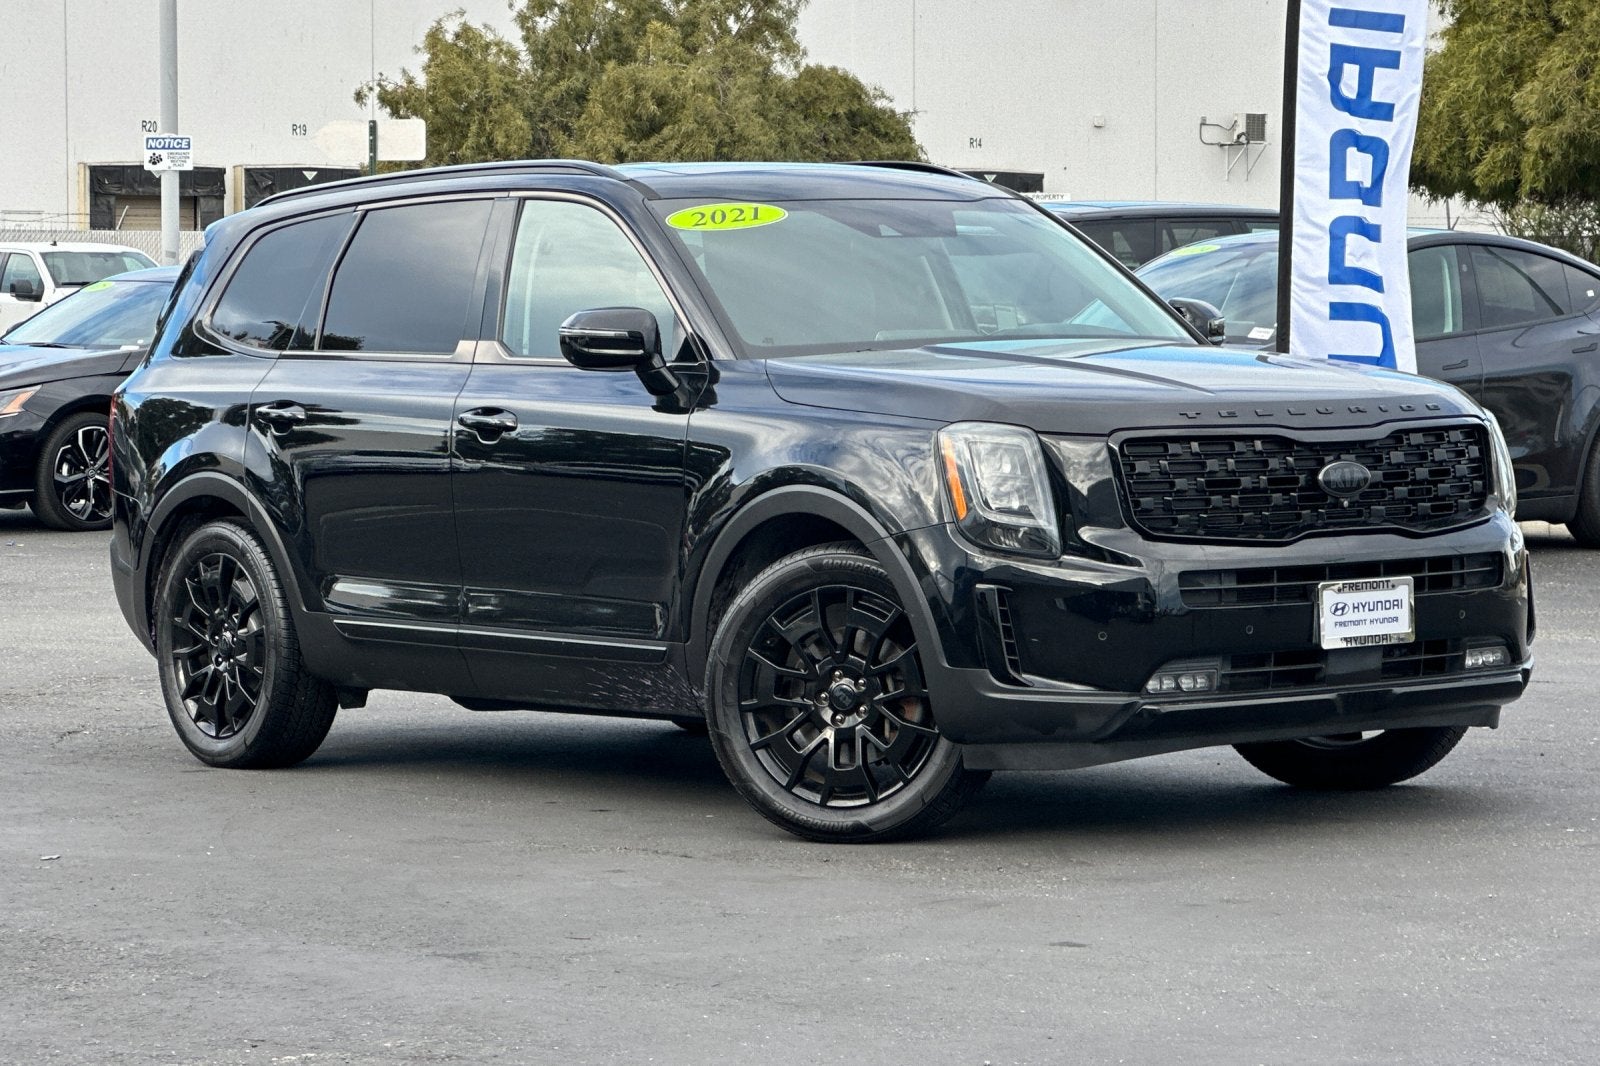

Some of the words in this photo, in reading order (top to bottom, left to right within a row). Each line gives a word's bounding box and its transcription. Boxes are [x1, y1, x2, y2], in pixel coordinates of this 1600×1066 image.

[141, 120, 158, 133] R20
[292, 124, 307, 136] R19
[147, 138, 190, 149] NOTICE
[969, 138, 982, 149] R14
[691, 207, 761, 227] 2021
[1179, 403, 1441, 419] TELLURIDE
[1330, 467, 1366, 489] KIA
[1342, 579, 1391, 592] FREMONT
[1352, 598, 1403, 614] HYUNDAI
[1334, 618, 1367, 628] FREMONT
[1369, 616, 1399, 626] HYUNDAI
[1344, 633, 1392, 647] HYUNDAI
